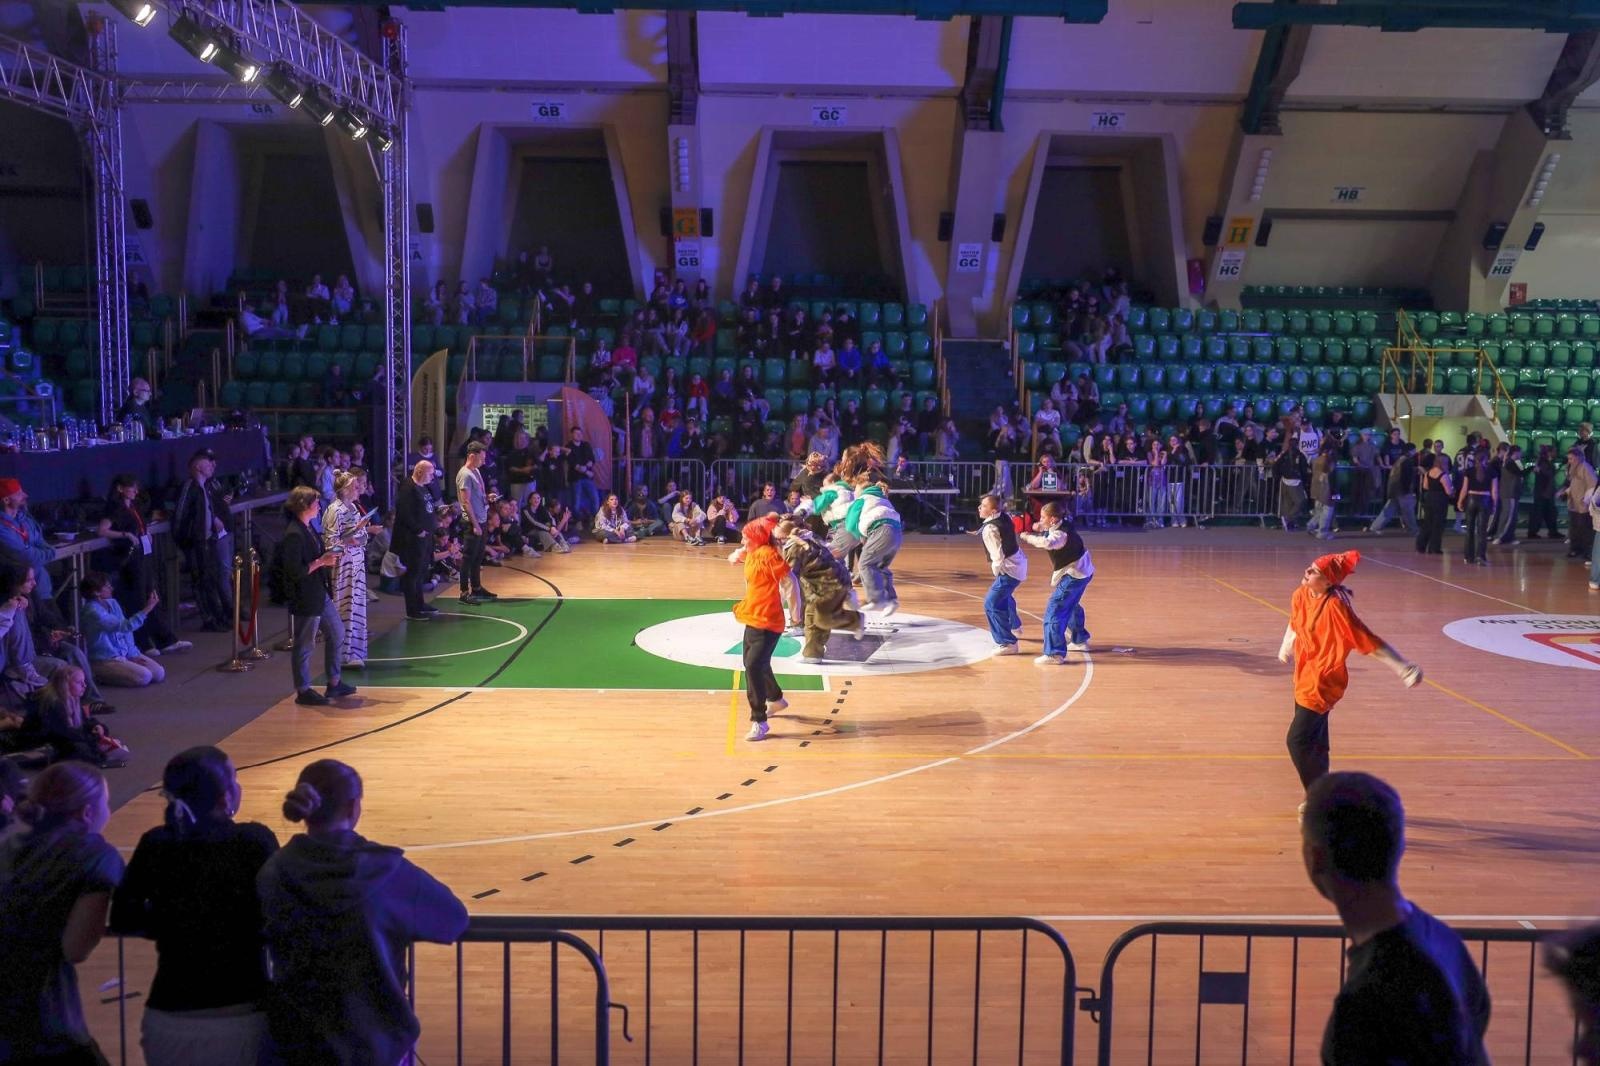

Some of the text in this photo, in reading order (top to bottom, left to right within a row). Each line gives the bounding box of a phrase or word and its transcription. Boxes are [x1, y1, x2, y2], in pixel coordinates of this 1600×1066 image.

[538, 106, 560, 117] GB
[819, 110, 840, 121] GC
[1098, 115, 1119, 126] HC
[1337, 190, 1359, 201] HB
[1230, 226, 1249, 243] H
[678, 257, 699, 267] GB
[959, 258, 979, 268] GC
[1219, 265, 1240, 276] HC
[1491, 265, 1513, 275] HB
